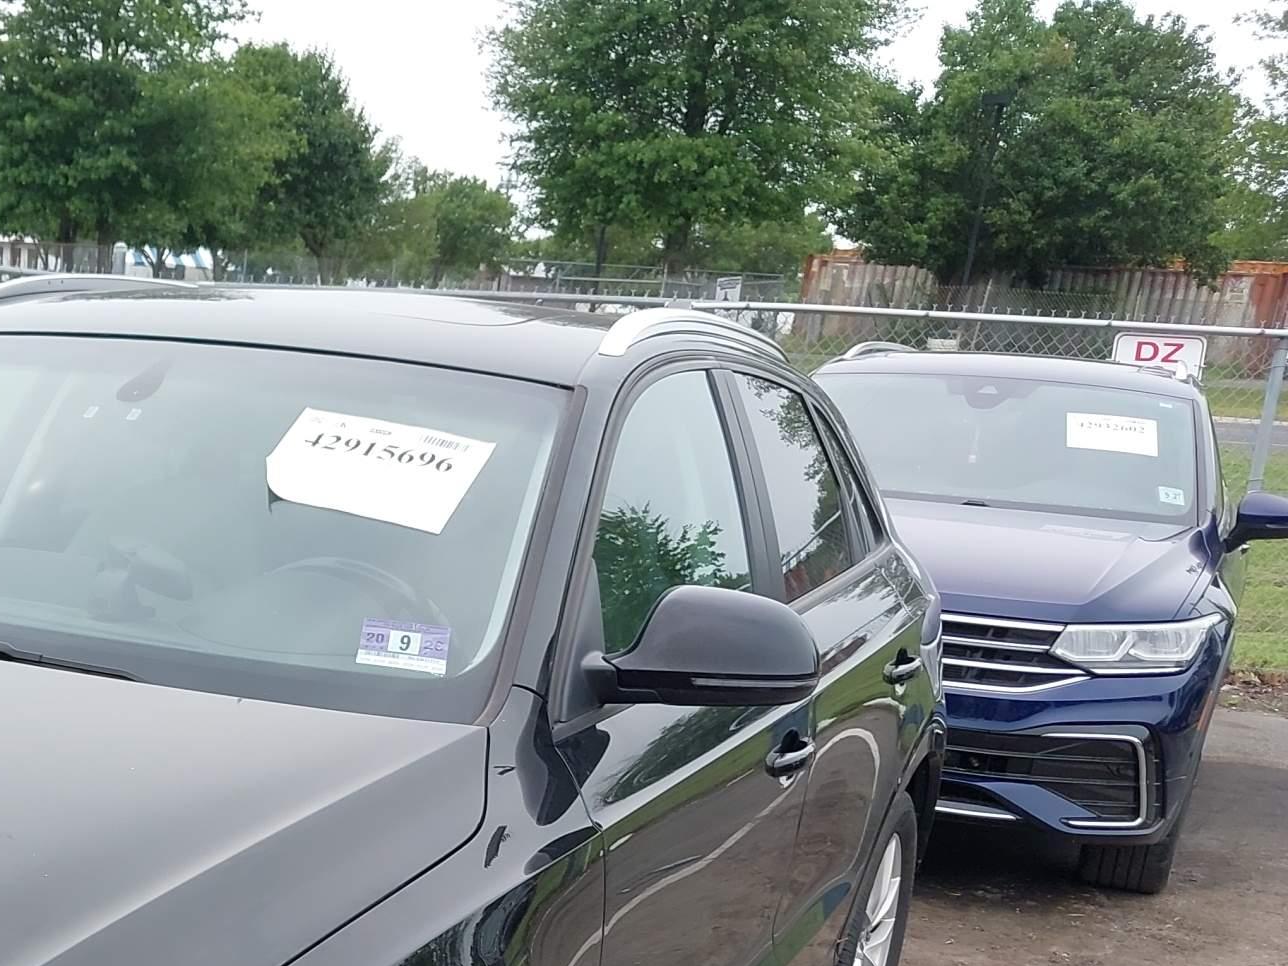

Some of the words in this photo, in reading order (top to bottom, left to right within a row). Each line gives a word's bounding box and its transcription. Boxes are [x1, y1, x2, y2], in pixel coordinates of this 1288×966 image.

[1134, 340, 1184, 363] DZ
[304, 432, 453, 473] 42915696
[365, 632, 386, 644] 20
[399, 634, 412, 652] 9
